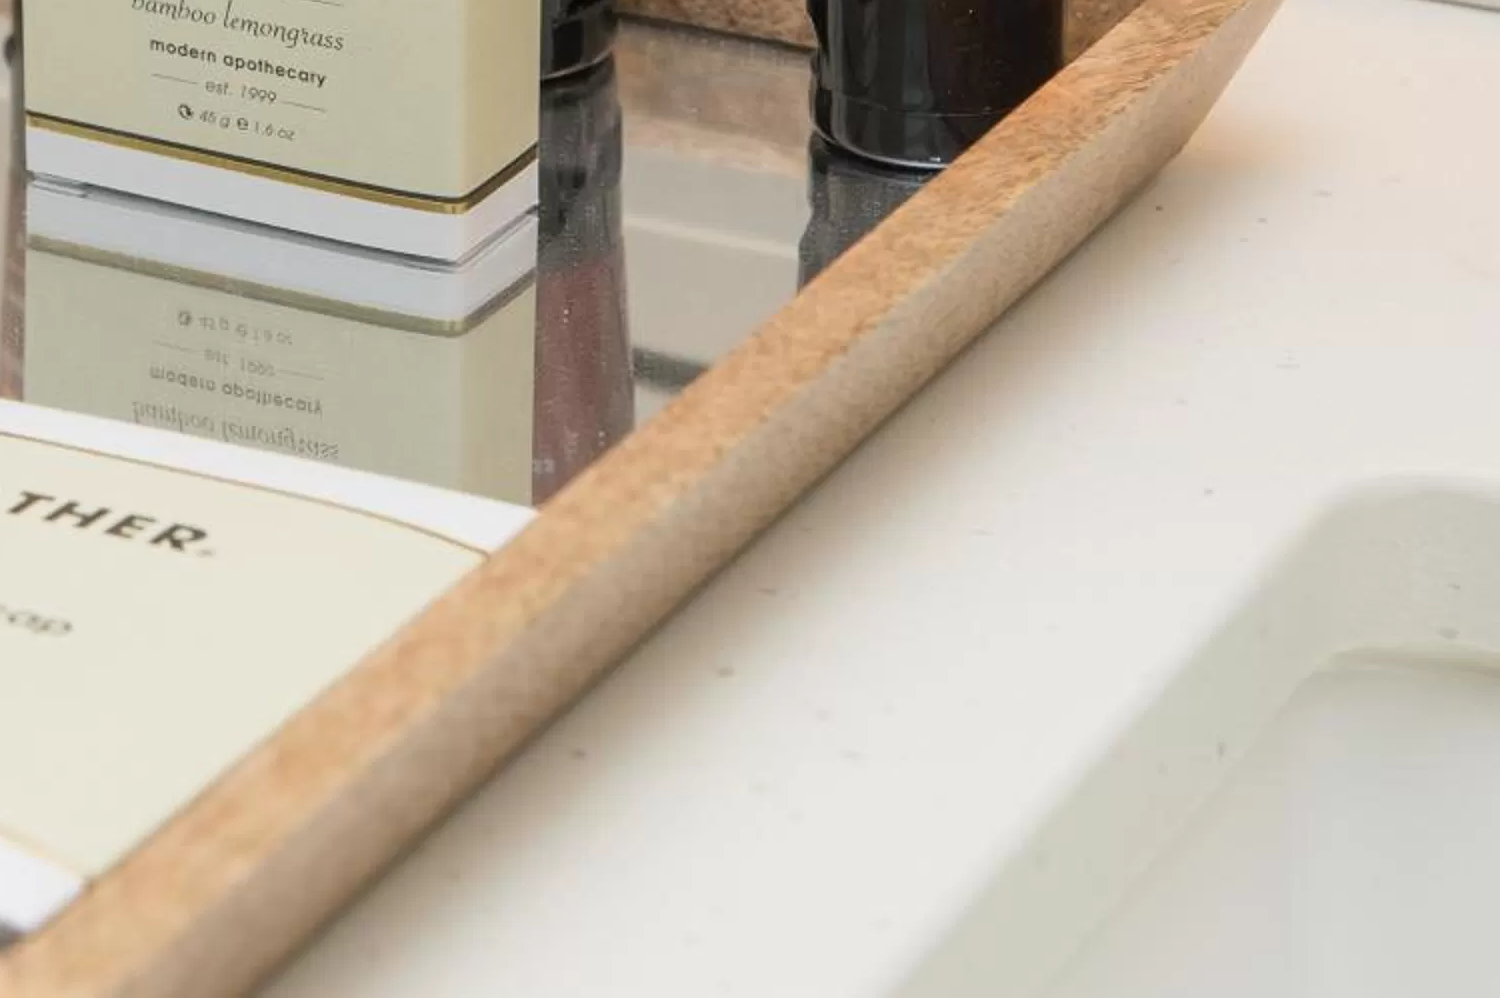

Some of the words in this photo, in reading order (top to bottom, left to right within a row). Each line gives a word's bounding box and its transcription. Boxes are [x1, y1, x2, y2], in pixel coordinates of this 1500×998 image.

[149, 37, 217, 64] modern
[222, 53, 327, 89] apothecary
[240, 85, 277, 105] 1999
[276, 126, 296, 142] oz
